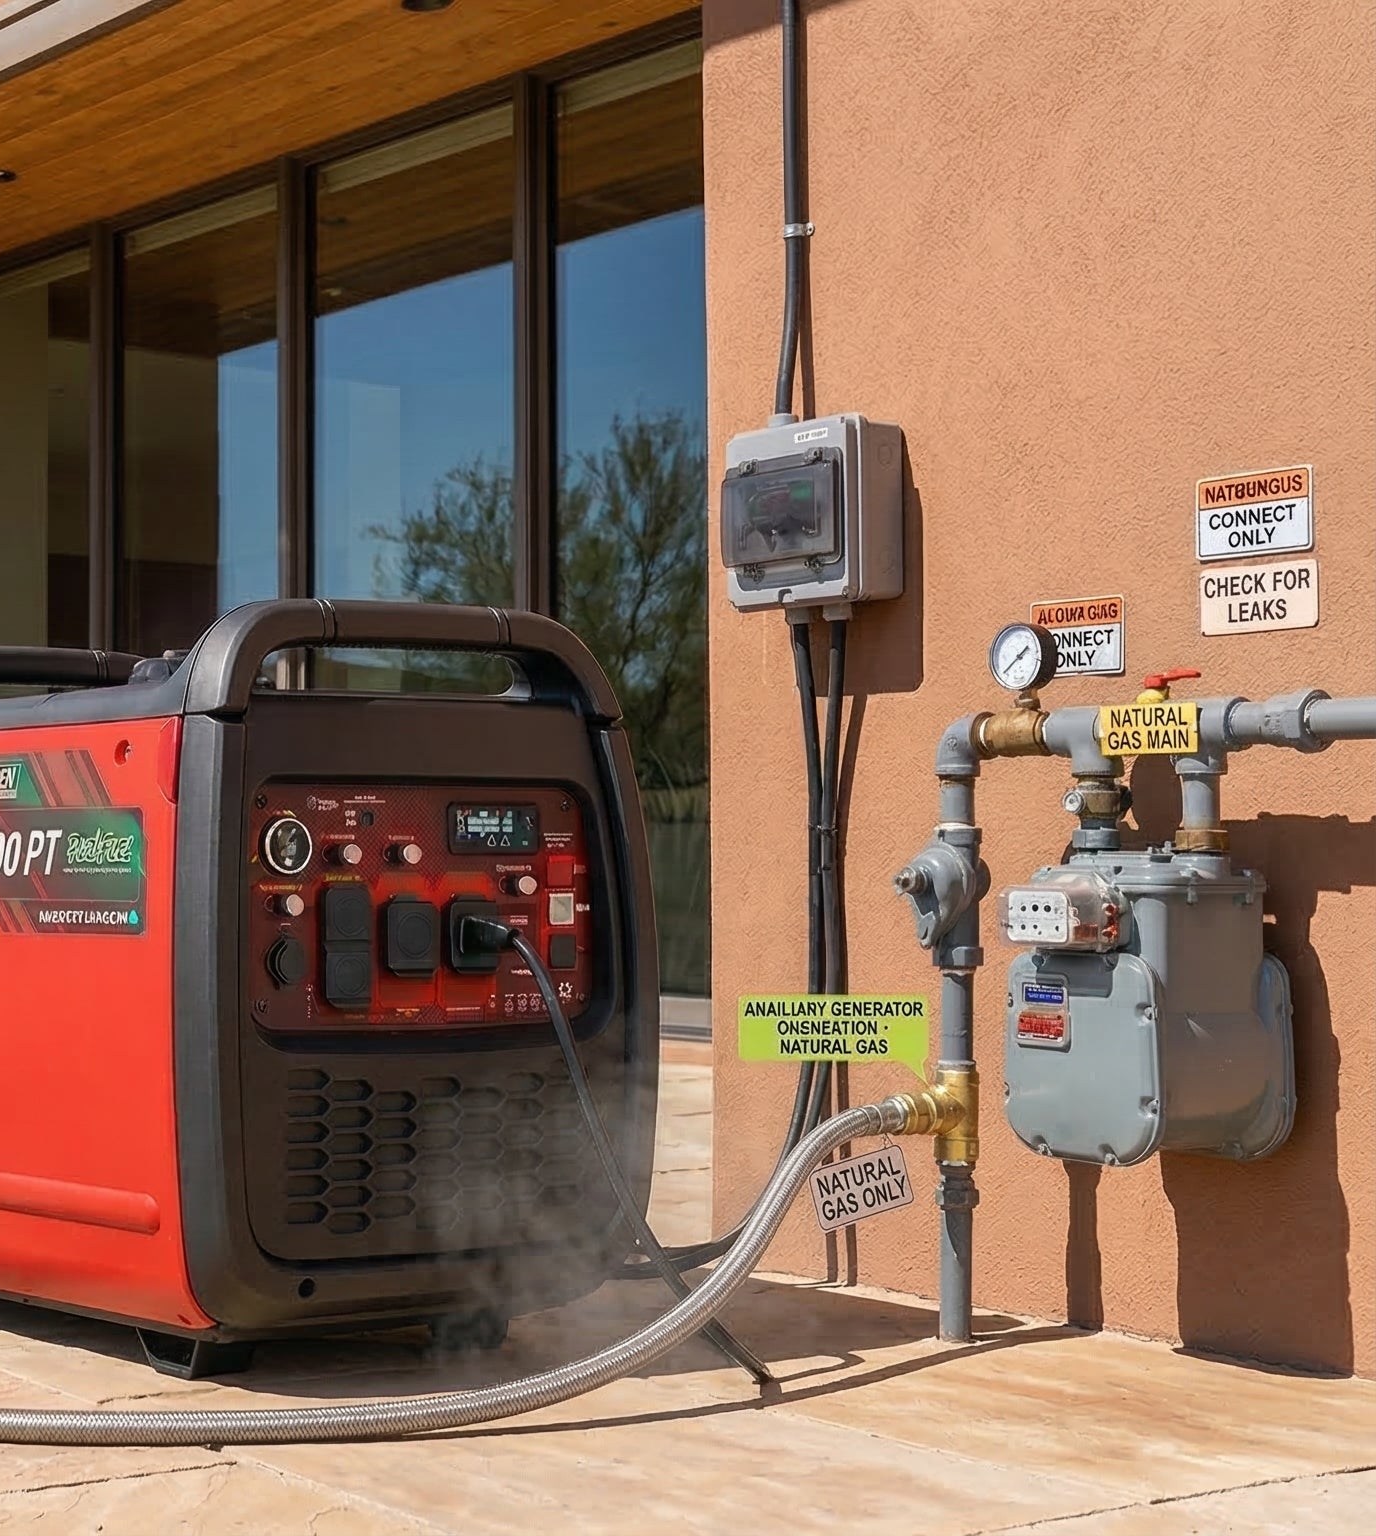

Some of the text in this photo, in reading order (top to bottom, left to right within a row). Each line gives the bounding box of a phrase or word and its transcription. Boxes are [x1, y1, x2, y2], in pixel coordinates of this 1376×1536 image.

[1209, 503, 1297, 530] CONNECT
[1228, 526, 1276, 548] ONLY
[1204, 568, 1310, 598] CHECK FOR
[1228, 598, 1287, 623] LEAKS
[1052, 629, 1114, 649] ONNECT
[1110, 706, 1187, 728] NATURAL
[1107, 729, 1189, 751] GAS MAIN
[23, 829, 63, 876] PT
[831, 1001, 924, 1017] GENERATOR
[777, 1020, 878, 1036] ONSNEATION
[780, 1039, 888, 1054] NATURAL GAS
[816, 1155, 901, 1198] NATURAL
[822, 1175, 906, 1221] GAS ONLY
